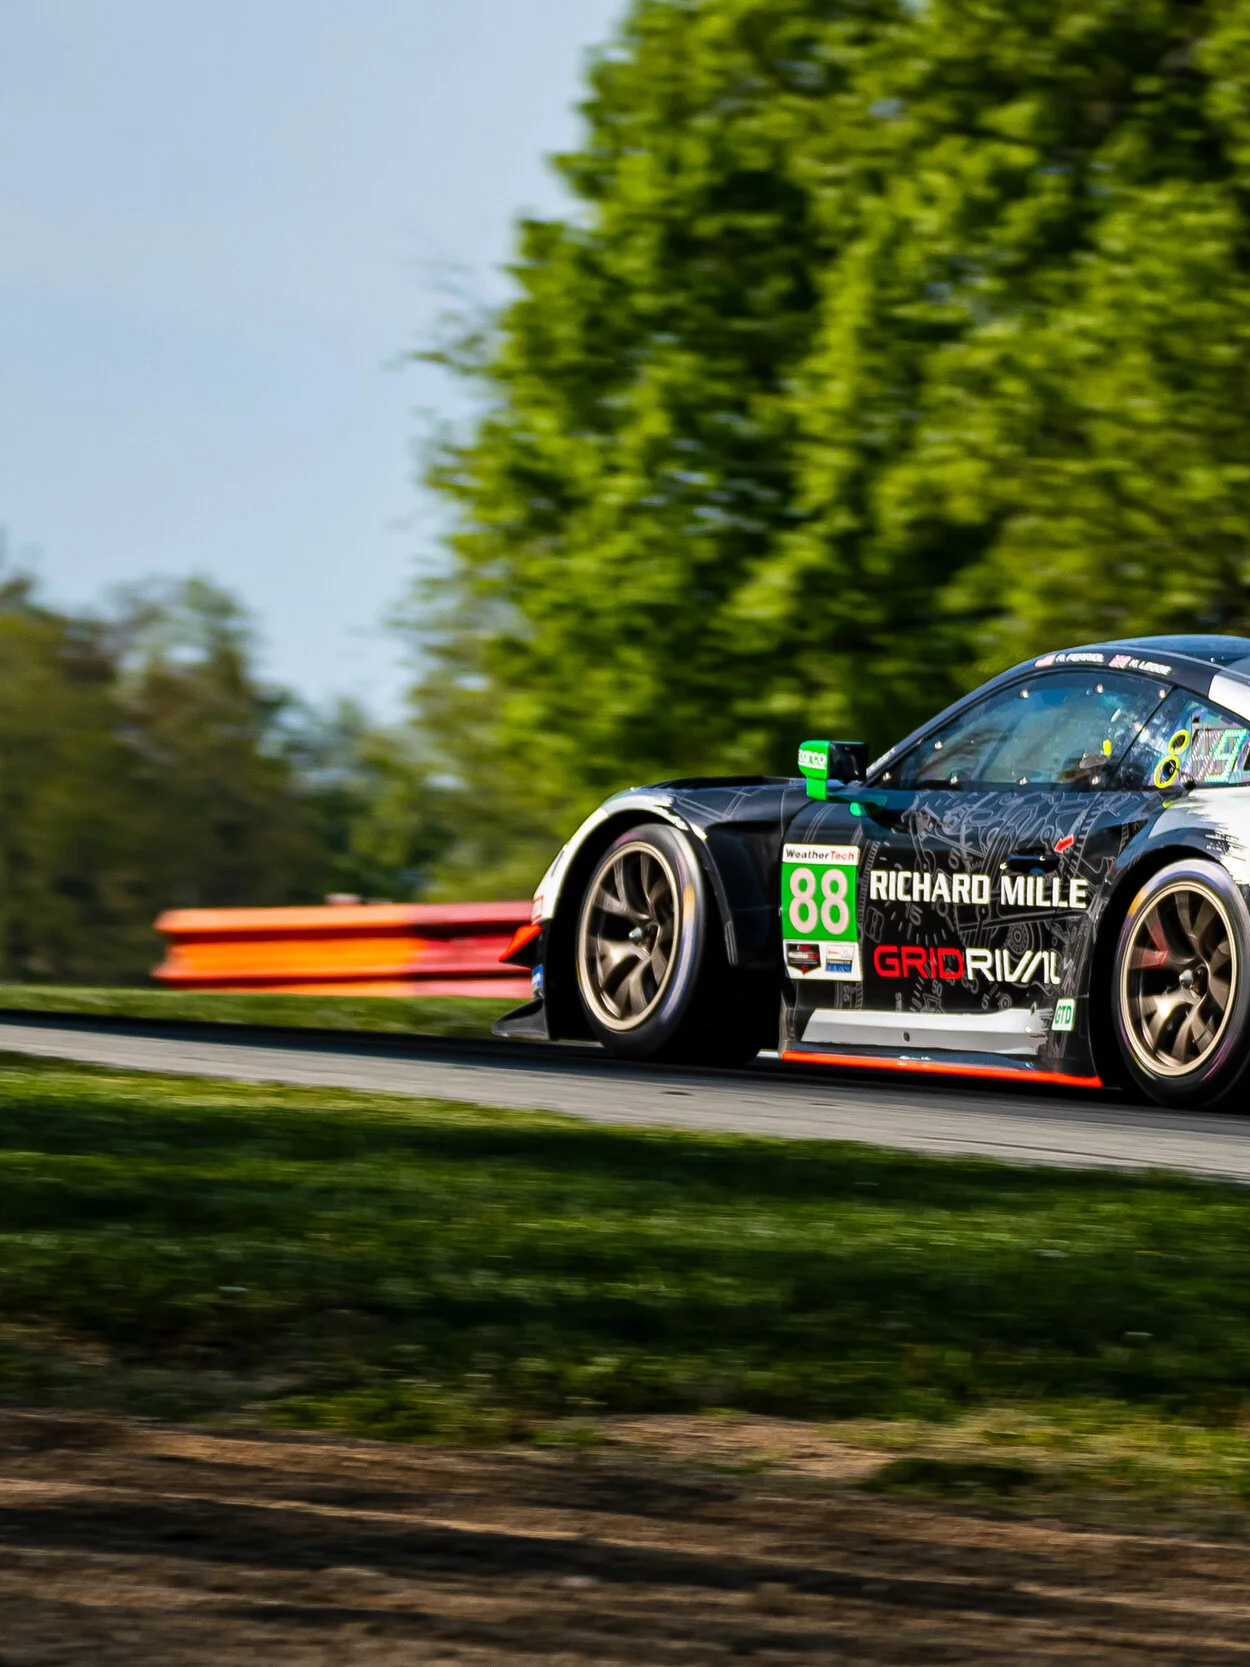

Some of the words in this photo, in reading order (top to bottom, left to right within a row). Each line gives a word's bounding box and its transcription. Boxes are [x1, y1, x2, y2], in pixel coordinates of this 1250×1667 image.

[786, 848, 855, 860] WeatherTech
[789, 866, 850, 935] 88
[870, 870, 991, 905] RICHARD
[1000, 875, 1089, 910] MILLE
[873, 944, 1063, 985] GRIDRIVAL
[1055, 1005, 1073, 1025] GTD
